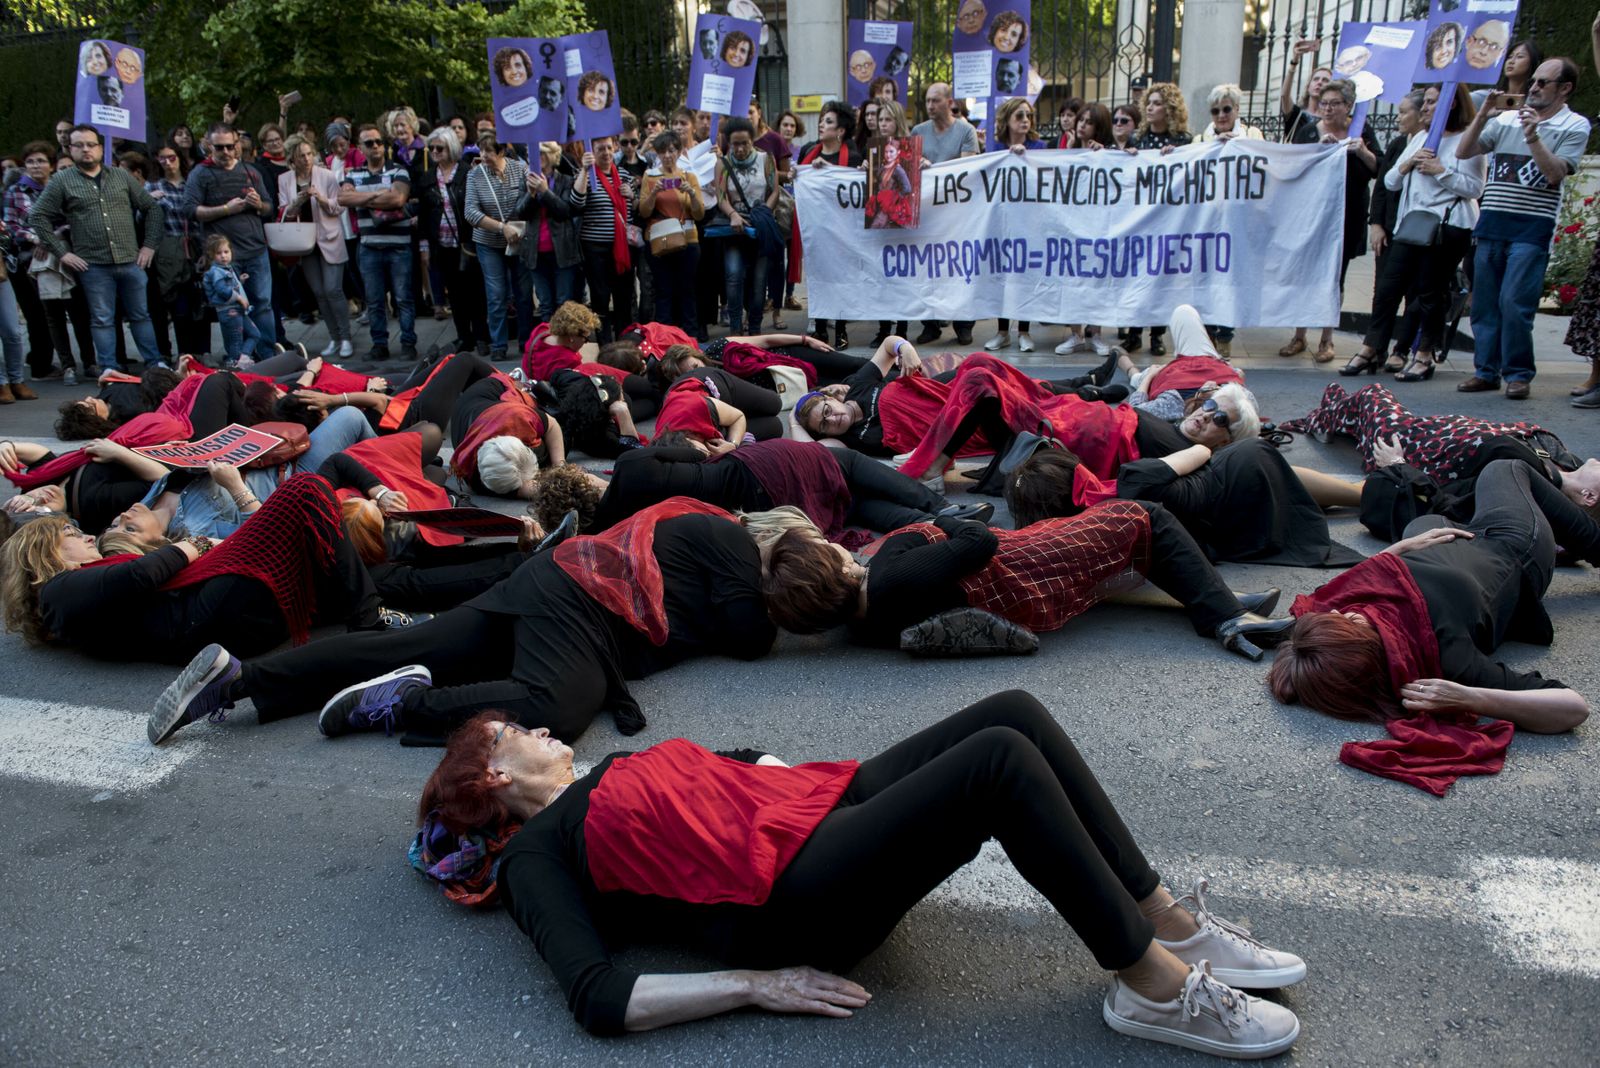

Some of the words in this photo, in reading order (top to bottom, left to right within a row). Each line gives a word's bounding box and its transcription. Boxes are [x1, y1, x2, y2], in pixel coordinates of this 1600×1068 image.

[933, 171, 973, 206] LAS
[980, 165, 1123, 206] VIOLENCIAS
[1135, 154, 1269, 206] MACHISTAS
[144, 428, 248, 459] MACHISMO
